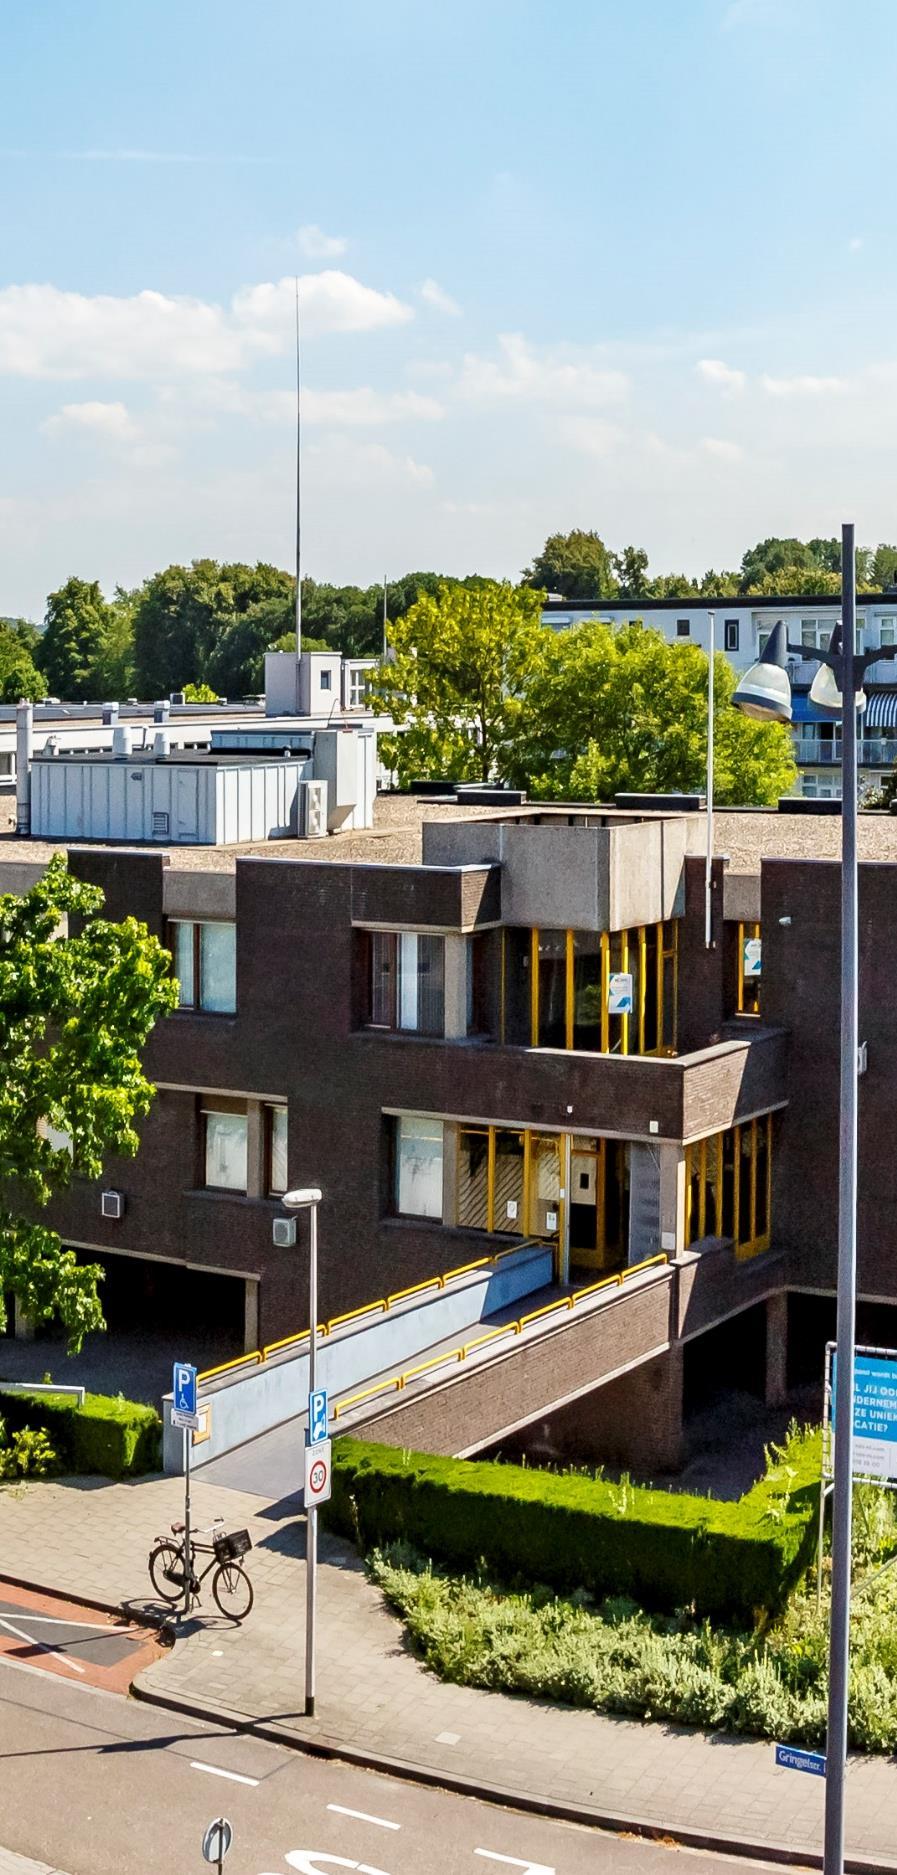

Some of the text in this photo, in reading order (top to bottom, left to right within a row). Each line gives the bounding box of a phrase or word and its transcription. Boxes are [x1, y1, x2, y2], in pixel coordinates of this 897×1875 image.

[178, 1368, 191, 1392] P
[863, 1384, 878, 1394] JIJ
[880, 1386, 897, 1397] OO
[313, 1394, 324, 1423] P
[854, 1407, 867, 1417] ZE
[854, 1420, 888, 1433] CATIE?
[313, 1469, 324, 1484] 30
